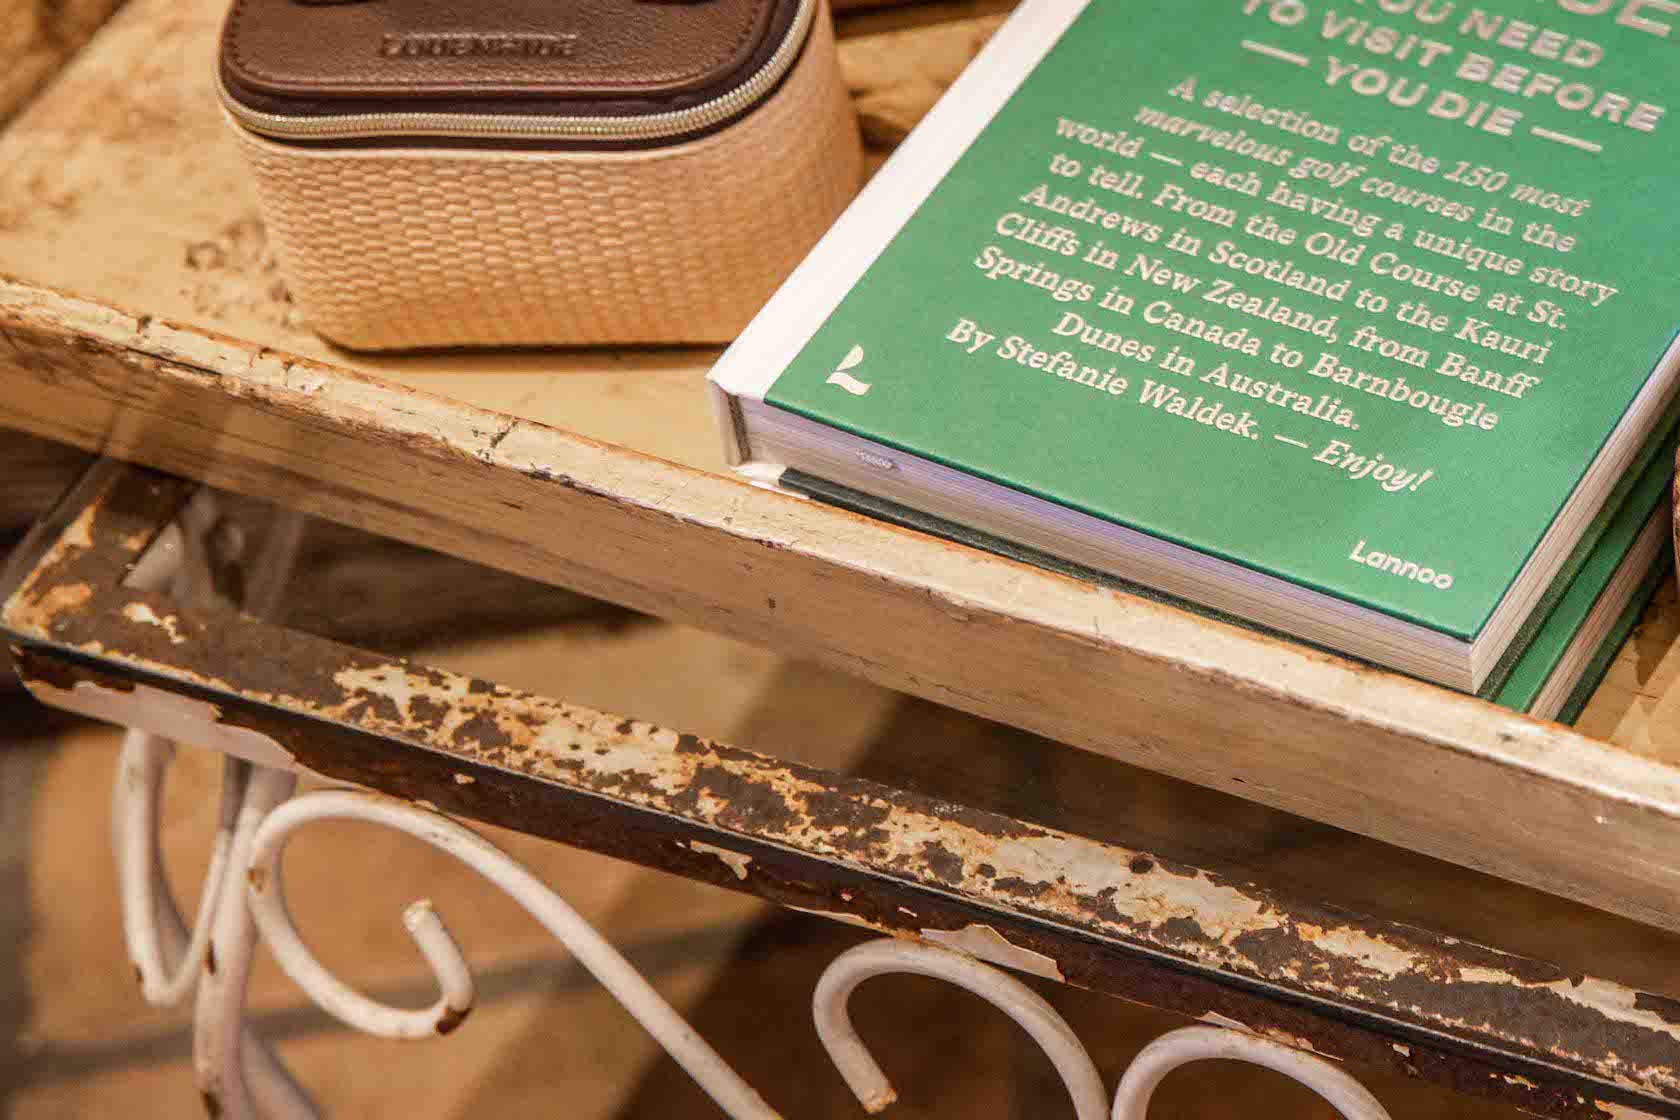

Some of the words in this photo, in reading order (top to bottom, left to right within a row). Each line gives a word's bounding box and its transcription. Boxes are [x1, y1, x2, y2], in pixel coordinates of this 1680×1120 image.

[1321, 11, 1452, 67] VISIT
[1456, 52, 1665, 134] BEFORE
[1324, 56, 1428, 107] YOU
[1427, 91, 1521, 137] DIE
[1459, 9, 1604, 68] NEED
[1055, 116, 1142, 158] world
[1190, 162, 1261, 196] each
[1268, 184, 1381, 238] having
[1384, 223, 1403, 241] a
[1413, 230, 1523, 276] unique
[1529, 267, 1617, 307] story
[1135, 107, 1291, 165] marvelous
[1288, 158, 1367, 187] golf
[1361, 178, 1476, 222] courses
[1478, 207, 1513, 235] in
[1523, 223, 1577, 253] the
[1170, 78, 1198, 102] A
[1202, 90, 1341, 145] selection
[1348, 135, 1393, 156] of
[1387, 144, 1440, 174] the
[1444, 160, 1509, 193] 150
[1511, 183, 1592, 217] most
[995, 212, 1075, 257] Cliffs
[1083, 240, 1120, 270] in
[1123, 253, 1202, 293] New
[1205, 280, 1340, 345] Zealand,
[1348, 326, 1430, 368] from
[1437, 352, 1542, 399] Banff
[1022, 182, 1163, 242] Andrews
[1167, 228, 1202, 256] in
[1209, 239, 1351, 302] Scotland
[1356, 289, 1389, 313] to
[1396, 303, 1449, 331] the
[1456, 317, 1552, 365] Kauri
[1048, 153, 1081, 177] to
[1088, 166, 1145, 199] tell.
[1152, 183, 1236, 227] From
[1245, 216, 1297, 244] the
[1304, 232, 1366, 265] Old
[1370, 253, 1481, 303] Course
[1487, 293, 1521, 314] at
[1527, 300, 1568, 331] St.
[949, 319, 995, 353] By
[997, 335, 1129, 396] Stefanie
[1140, 379, 1259, 441] Waldek.
[1311, 439, 1433, 493] Enjoy!
[976, 244, 1092, 302] Springs
[1101, 287, 1137, 315] in
[1143, 301, 1261, 356] Canada
[1270, 343, 1303, 369] to
[1312, 352, 1499, 433] Barnbougle
[1053, 311, 1156, 361] Dunes
[1159, 349, 1195, 376] in
[1200, 366, 1360, 431] Australia.
[1350, 537, 1454, 590] Lannoo
